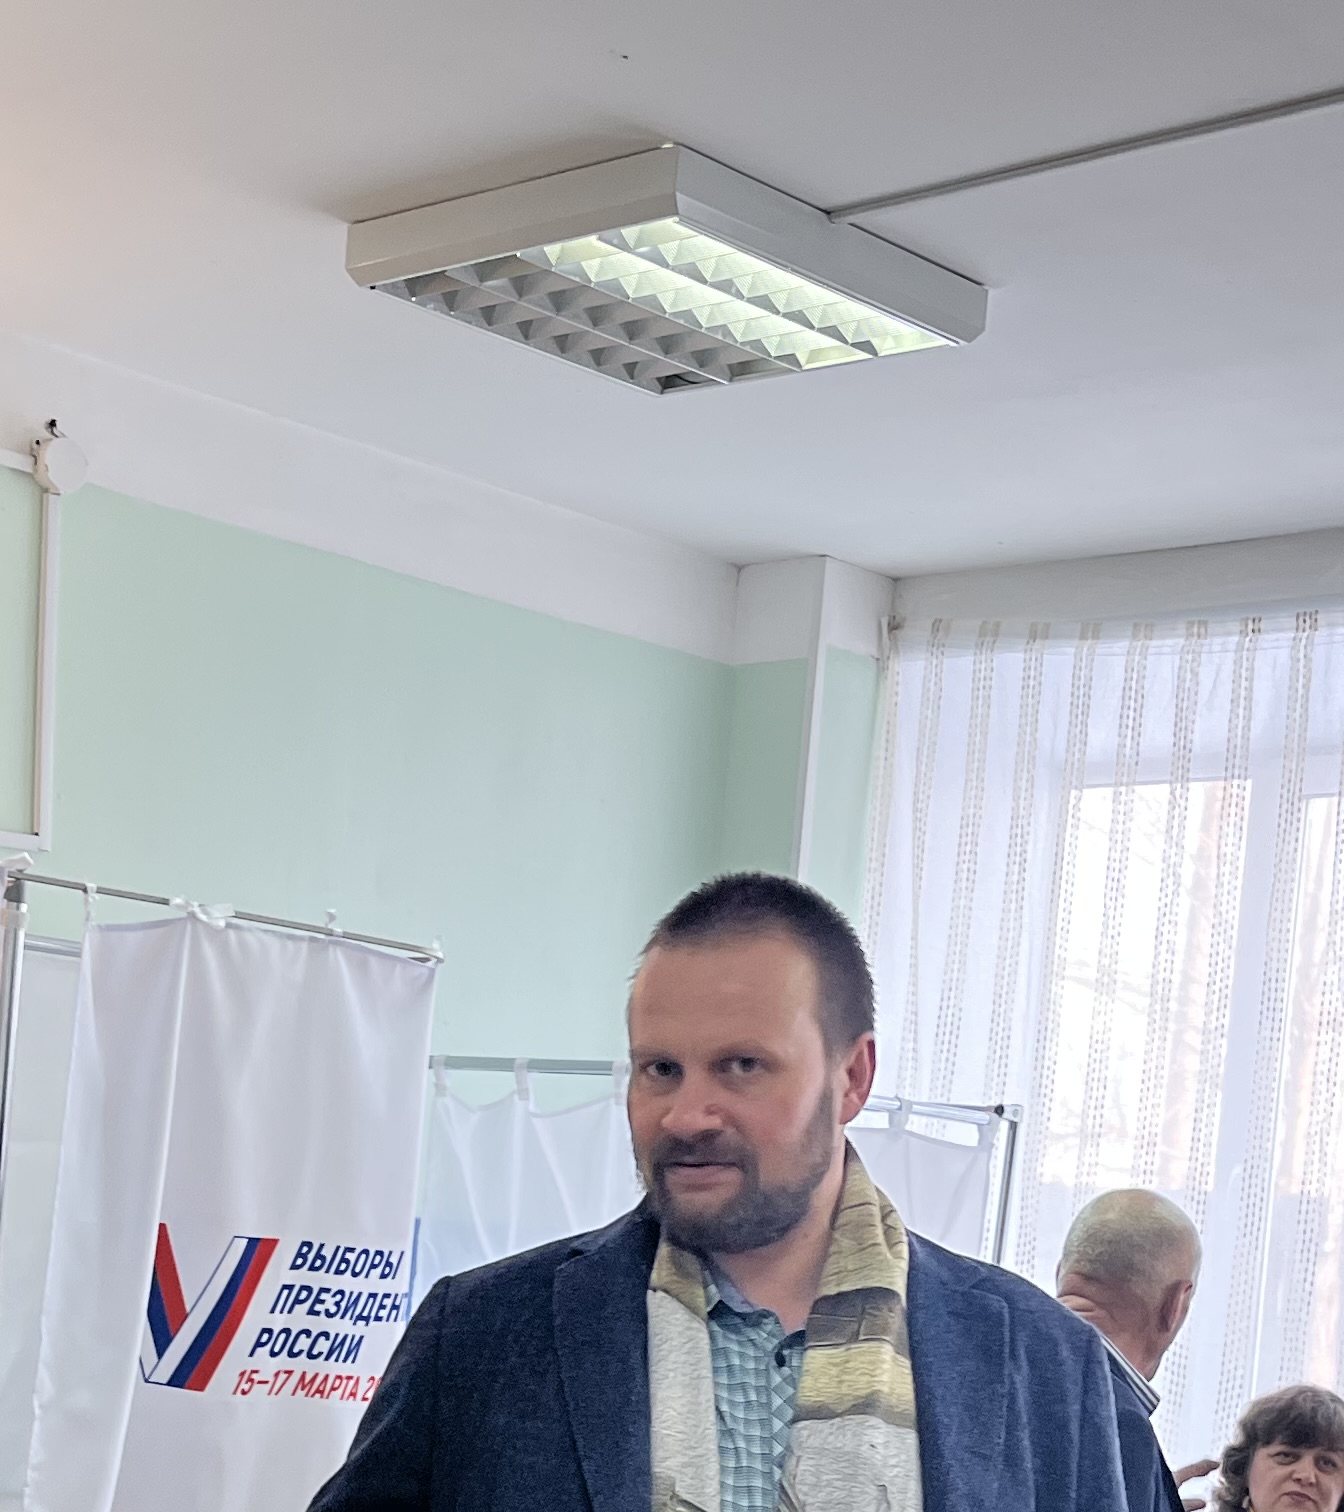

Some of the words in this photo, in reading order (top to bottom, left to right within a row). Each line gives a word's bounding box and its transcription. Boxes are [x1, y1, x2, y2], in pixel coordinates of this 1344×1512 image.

[289, 1240, 404, 1280] ВЫБОРЫ
[248, 1327, 365, 1364] РОССИИ
[291, 1371, 361, 1401] МАРТА
